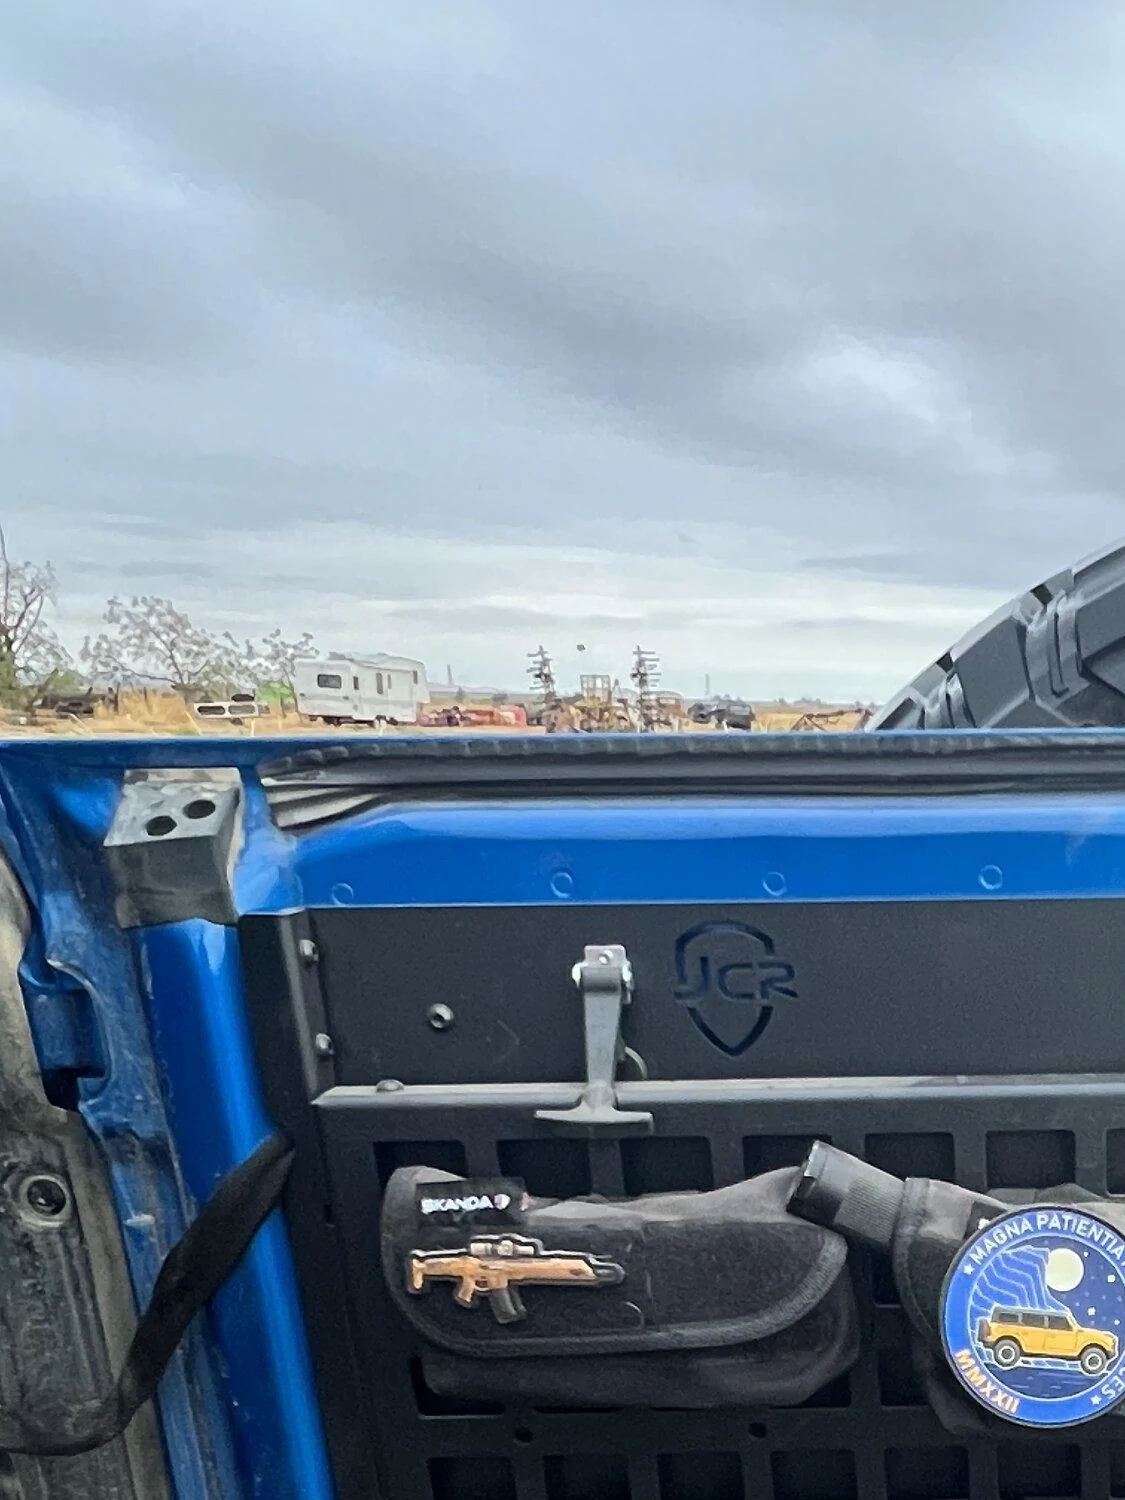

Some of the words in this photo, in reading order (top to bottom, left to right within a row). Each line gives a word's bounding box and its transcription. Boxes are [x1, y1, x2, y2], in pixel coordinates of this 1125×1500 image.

[674, 956, 798, 1000] JCR
[969, 1216, 1034, 1266] MAGNA
[1036, 1212, 1125, 1262] PATIENTIA
[954, 1348, 1021, 1415] MMXXII
